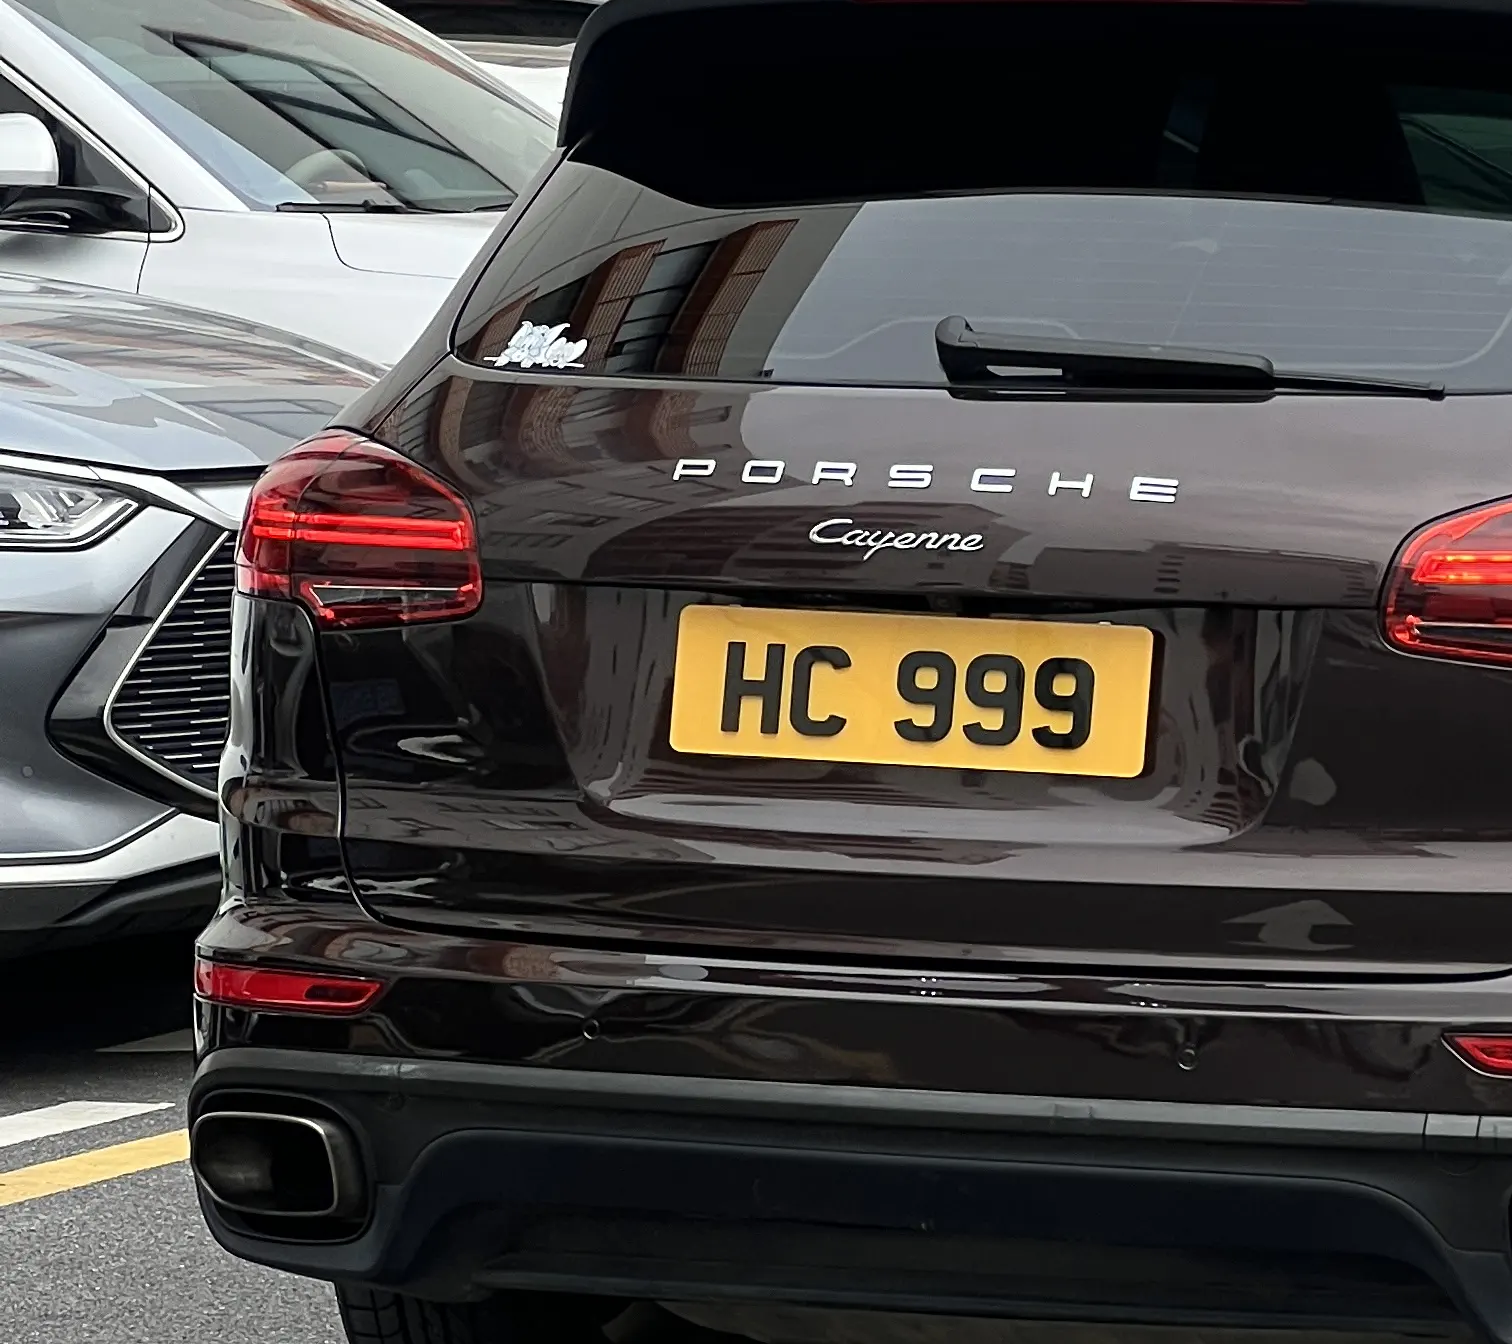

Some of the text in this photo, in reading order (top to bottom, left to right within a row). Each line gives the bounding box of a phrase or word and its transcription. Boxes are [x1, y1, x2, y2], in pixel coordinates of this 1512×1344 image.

[672, 459, 1180, 504] PORSCHE
[808, 518, 985, 561] Cayenne
[719, 640, 1097, 751] HC 999
